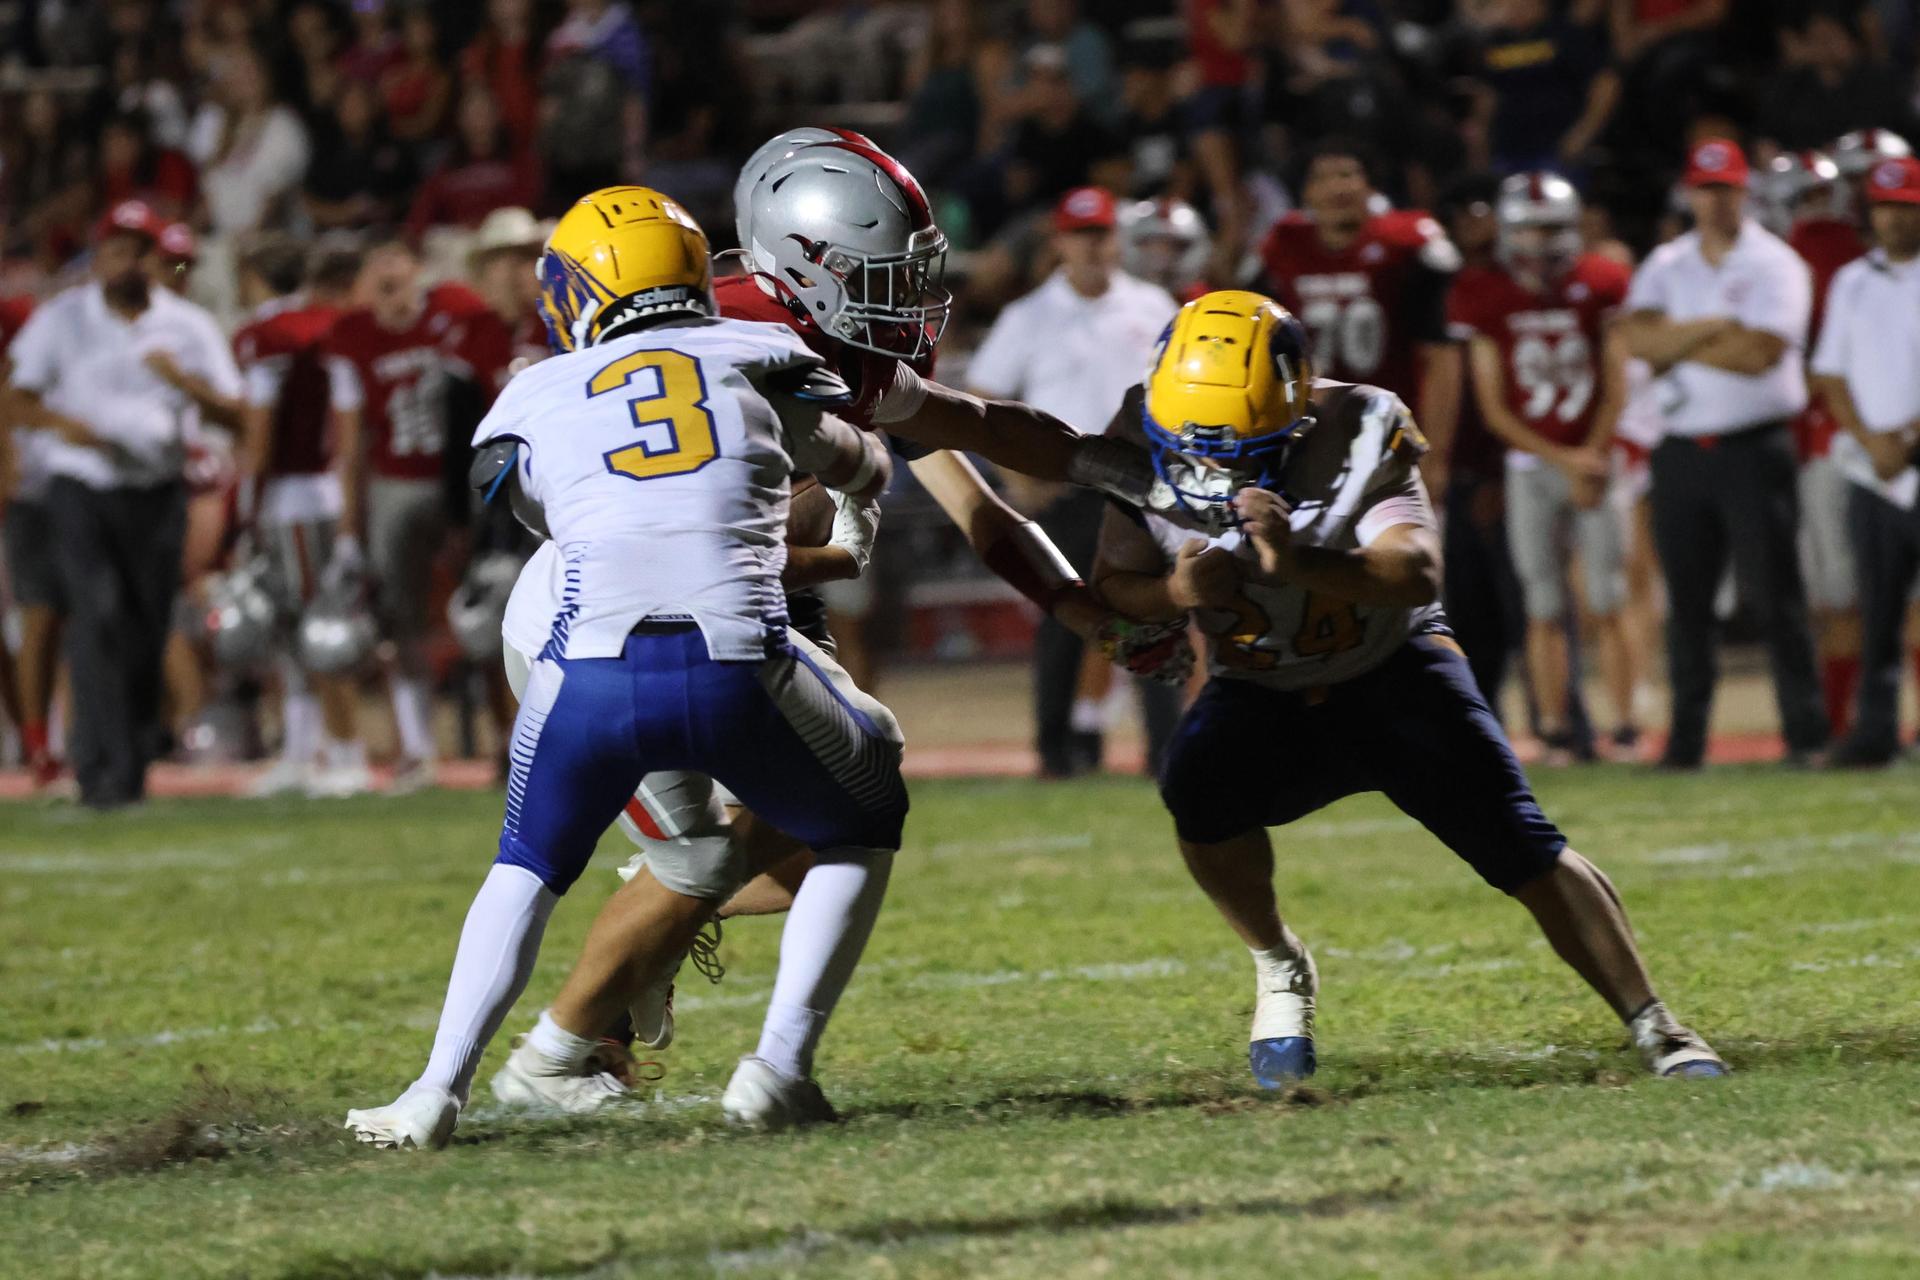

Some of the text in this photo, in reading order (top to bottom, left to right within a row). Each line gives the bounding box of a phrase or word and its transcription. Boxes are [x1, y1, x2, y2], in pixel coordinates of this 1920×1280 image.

[1301, 300, 1384, 373] 70
[1514, 336, 1593, 420] 99
[586, 348, 721, 481] 3
[1200, 585, 1369, 670] 24
